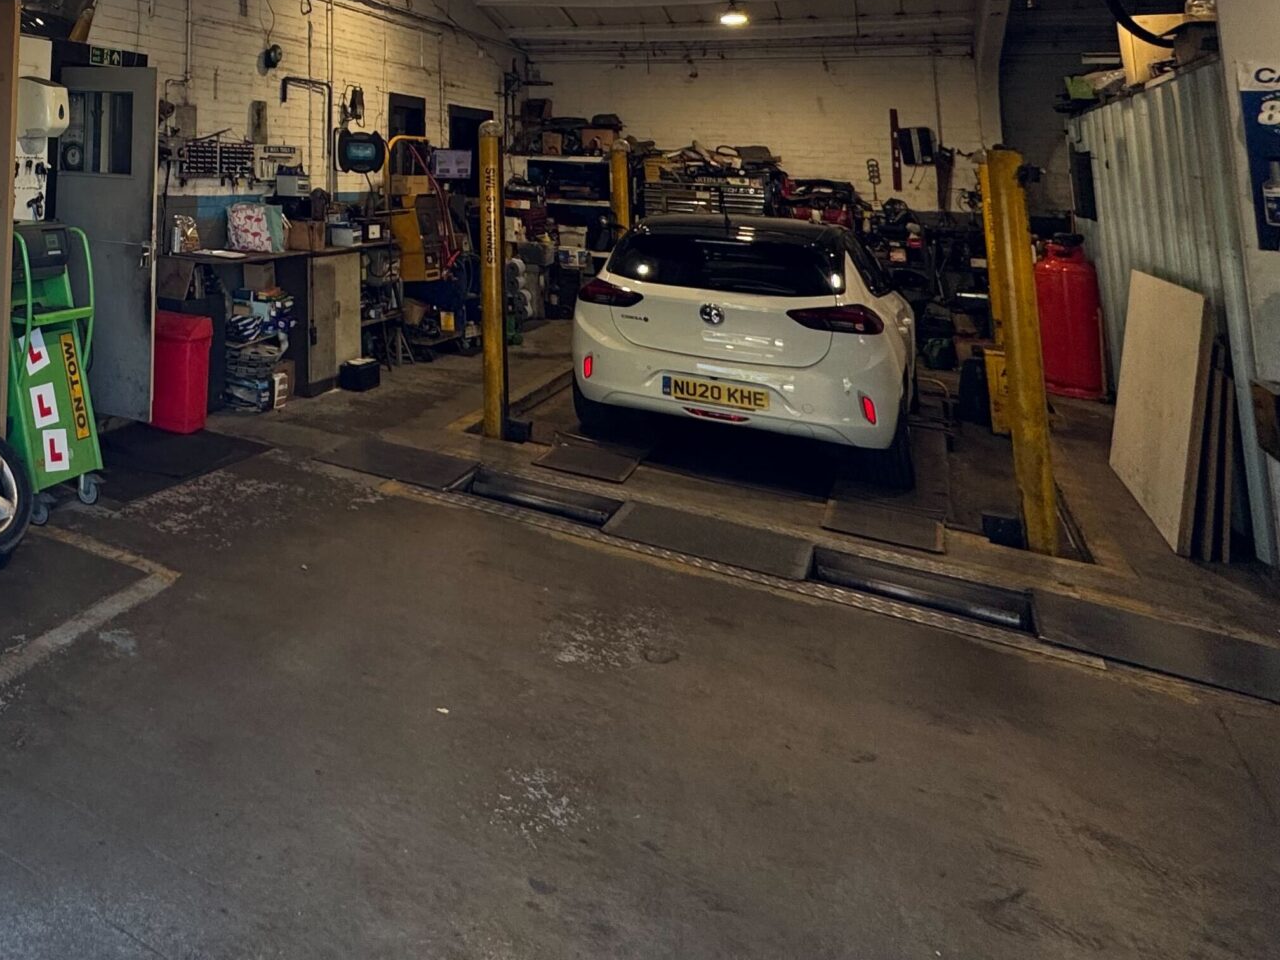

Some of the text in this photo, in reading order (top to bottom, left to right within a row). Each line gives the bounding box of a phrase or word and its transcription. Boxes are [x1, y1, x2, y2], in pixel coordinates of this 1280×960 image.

[28, 340, 43, 365] L
[64, 342, 86, 429] ON TOW
[673, 380, 765, 408] NU20 KHE
[37, 394, 52, 418] L
[49, 437, 63, 463] L
